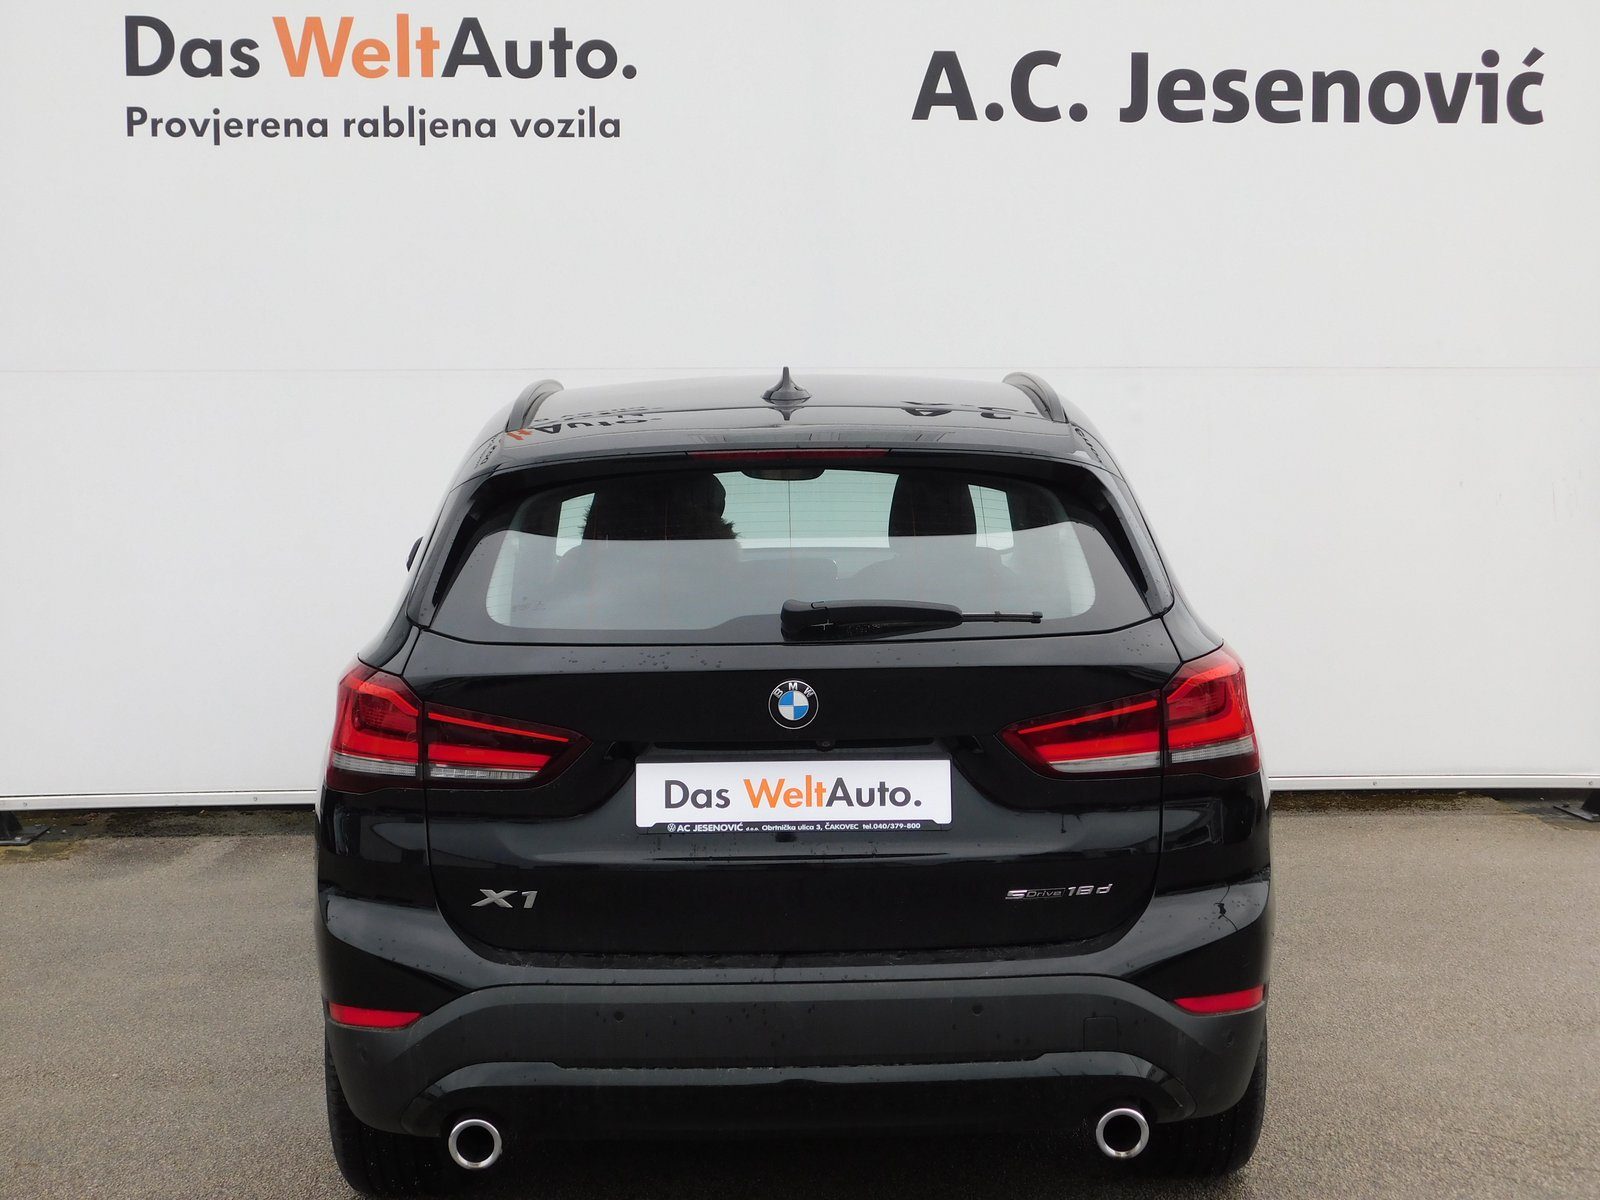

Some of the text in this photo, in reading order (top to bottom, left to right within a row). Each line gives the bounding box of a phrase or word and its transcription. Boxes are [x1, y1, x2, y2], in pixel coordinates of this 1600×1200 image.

[125, 14, 636, 79] Das WeltAuto.
[911, 47, 1545, 126] A.C. Jesenović
[126, 105, 621, 146] Provjerena rabljena vozila
[773, 682, 815, 698] BMW
[664, 774, 922, 809] Das WeltAuto.
[676, 824, 691, 832] AC
[692, 822, 743, 832] JESENOVIĆ
[797, 823, 815, 831] ulica
[824, 822, 859, 830] ČAKOVEC
[471, 889, 538, 909] X1
